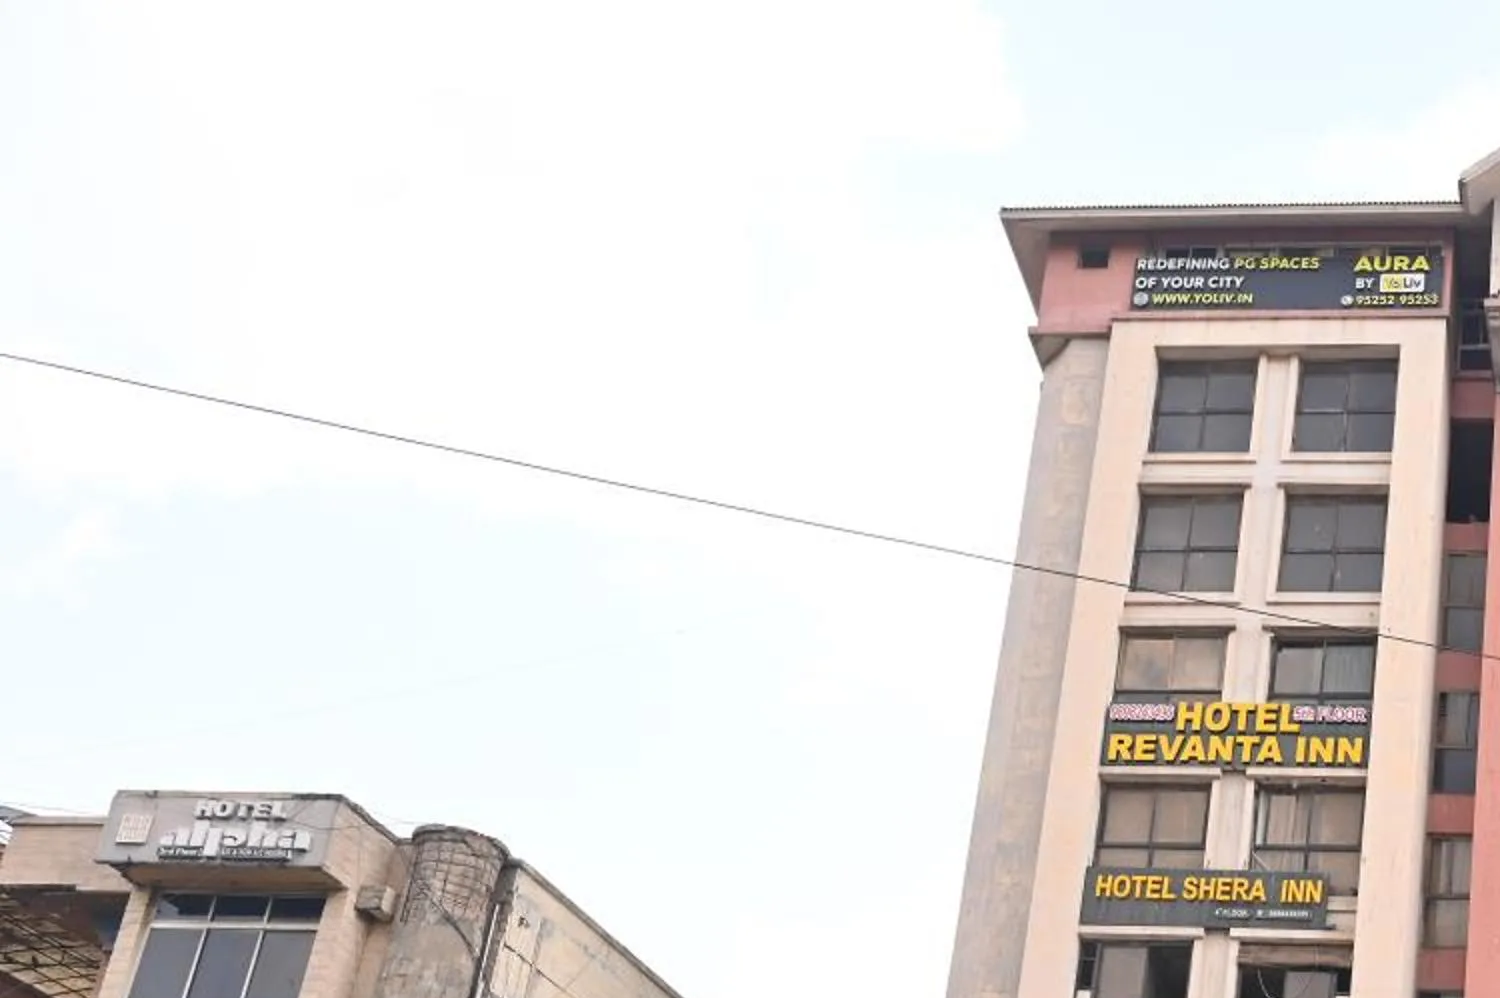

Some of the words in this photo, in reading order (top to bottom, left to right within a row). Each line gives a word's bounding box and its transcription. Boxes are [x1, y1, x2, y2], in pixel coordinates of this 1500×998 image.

[1137, 257, 1230, 270] REDEFINING
[1233, 257, 1256, 270] PG
[1259, 257, 1320, 270] SPACES
[1354, 255, 1431, 271] AURA
[1135, 276, 1157, 289] OF
[1161, 276, 1205, 289] YOUR
[1207, 276, 1245, 289] CITY
[1355, 277, 1375, 289] BY
[1151, 293, 1254, 305] WWW.YOLIV.IN
[1175, 702, 1300, 733] HOTEL
[1107, 734, 1284, 764] REVANTA
[1294, 736, 1365, 764] INN
[193, 800, 287, 819] HOTEL
[1094, 874, 1177, 901] HOTEL
[1182, 877, 1267, 904] SHERA
[1280, 879, 1324, 904] INN
